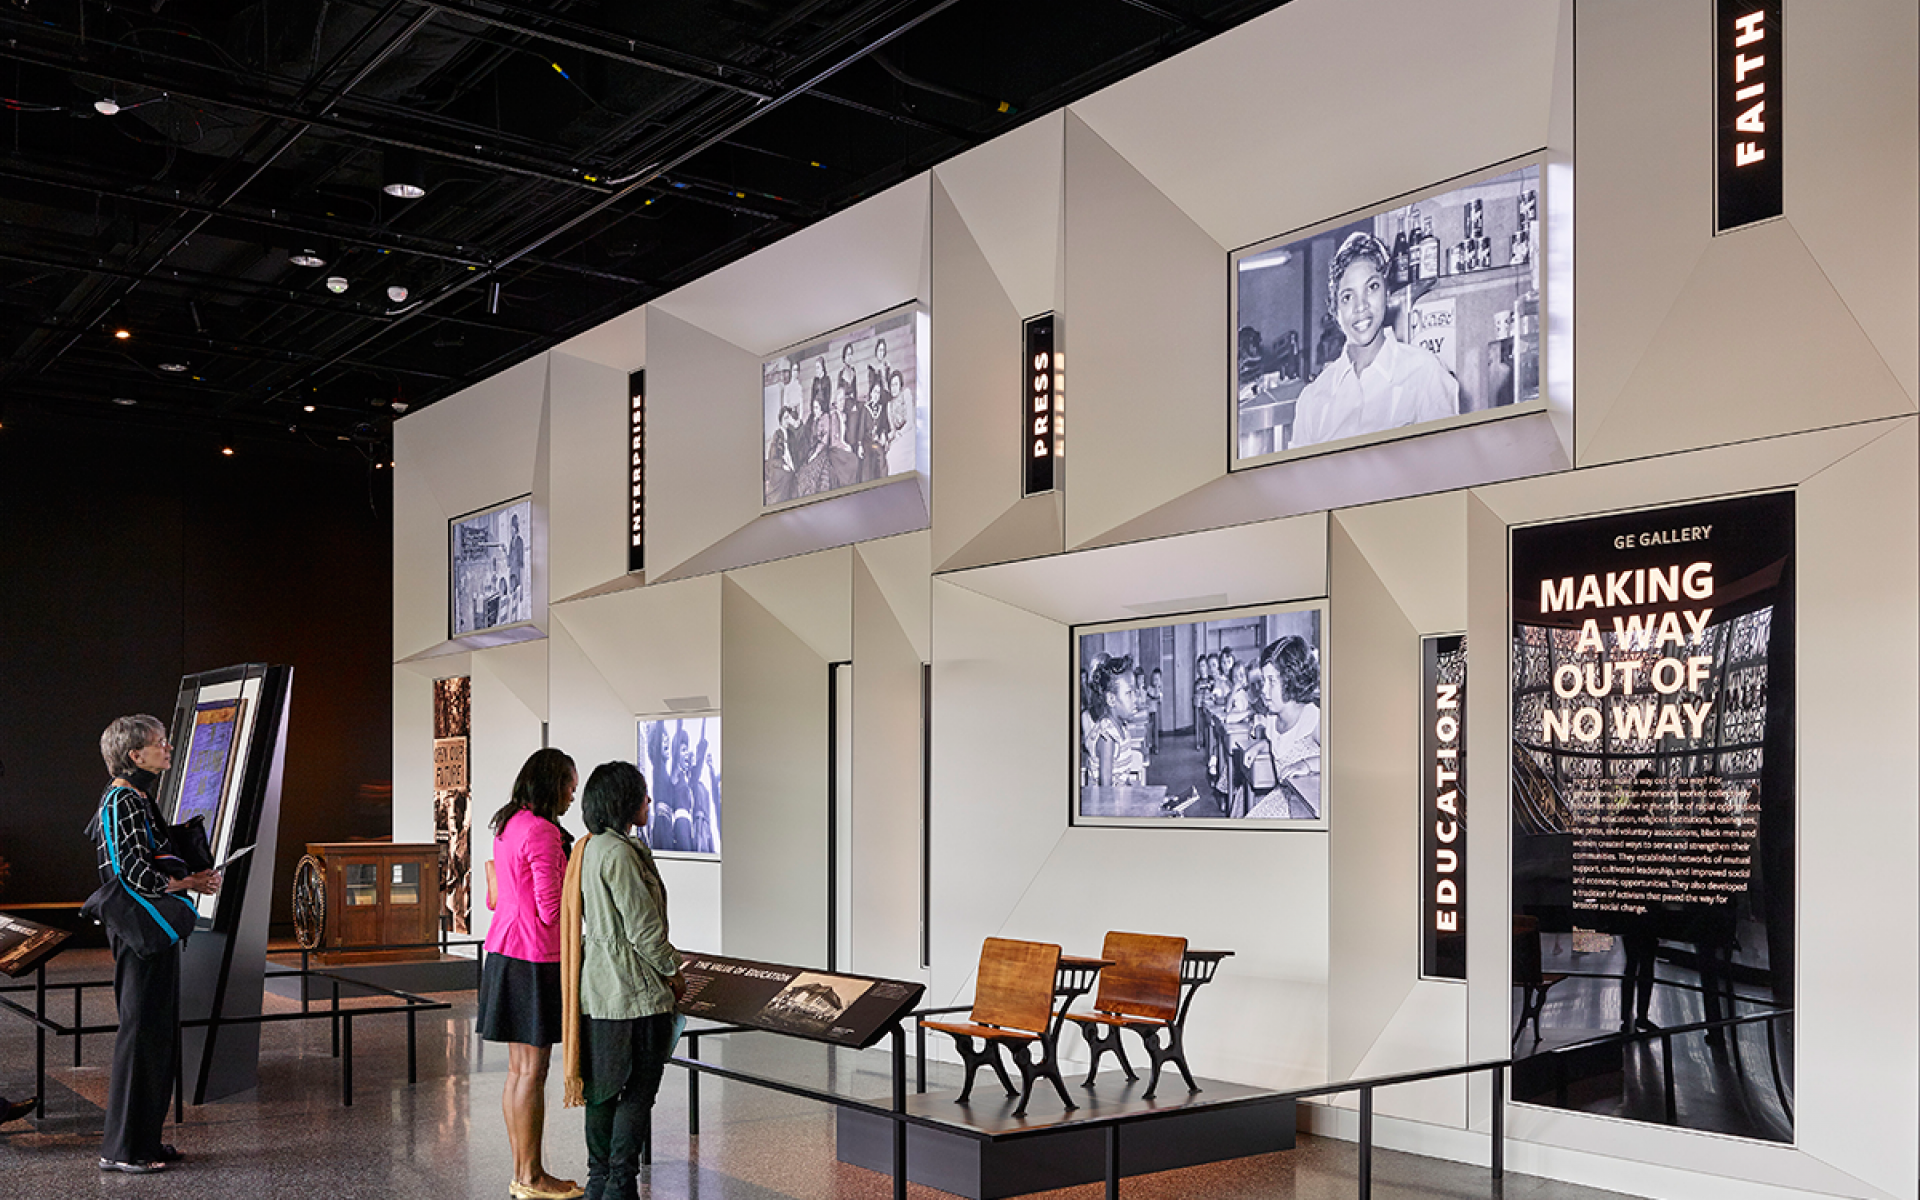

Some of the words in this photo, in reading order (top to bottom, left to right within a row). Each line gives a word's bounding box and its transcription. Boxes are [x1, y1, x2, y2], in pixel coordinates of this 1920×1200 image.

[1735, 9, 1765, 167] FAITH
[1034, 352, 1049, 457] PRESS
[632, 394, 642, 547] ENTERPRISE
[1614, 533, 1635, 549] GE
[1639, 524, 1713, 547] GALLERY
[1540, 562, 1714, 613] MAKING
[1577, 618, 1604, 653] A
[1612, 608, 1713, 652] WAY
[1553, 661, 1641, 699] OUT
[1652, 656, 1712, 695] OF
[1543, 707, 1603, 743] NO
[1612, 702, 1712, 740] WAY
[1600, 778, 1613, 788] you
[1640, 778, 1653, 788] way
[1669, 776, 1677, 785] of
[1709, 775, 1722, 785] For
[1436, 684, 1459, 932] EDUCATION
[1685, 802, 1694, 811] of
[1696, 802, 1715, 811] racial
[1602, 815, 1637, 825] education,
[1638, 815, 1668, 826] religious
[1669, 815, 1712, 826] institutions,
[1573, 827, 1584, 835] the
[1586, 828, 1605, 838] press,
[1606, 827, 1619, 835] and
[1621, 828, 1652, 839] voluntary
[1654, 829, 1699, 838] associations,
[1701, 828, 1721, 837] black
[1741, 829, 1756, 838] and
[1598, 840, 1624, 848] created
[1625, 841, 1642, 852] ways
[1673, 841, 1689, 850] and
[1690, 841, 1730, 853] strengthen
[1731, 842, 1751, 851] their
[1618, 853, 1636, 864] They
[1637, 854, 1677, 862] established
[1678, 854, 1713, 863] networks
[1714, 854, 1722, 863] of
[1723, 855, 1751, 864] mutual
[1573, 865, 1600, 875] support,
[1601, 864, 1635, 874] cultivated
[1636, 865, 1674, 878] leadership,
[1675, 866, 1690, 875] and
[1691, 867, 1727, 879] improved
[1728, 868, 1751, 878] social
[1573, 876, 1585, 885] and
[1587, 877, 1619, 886] economic
[1621, 879, 1670, 889] opportunities.
[1671, 879, 1689, 891] They
[1691, 880, 1706, 889] also
[1707, 881, 1748, 893] developed
[1578, 889, 1607, 898] tradition
[1608, 889, 1617, 898] of
[1617, 891, 1645, 900] activism
[1646, 891, 1661, 900] that
[1662, 893, 1684, 904] paved
[1685, 893, 1698, 903] the
[1699, 895, 1715, 906] way
[1716, 894, 1728, 904] for
[1573, 900, 1599, 910] broader
[1621, 903, 1648, 916] change.
[694, 960, 711, 970] THE
[733, 965, 747, 975] OF
[744, 967, 792, 982] EDUCATION
